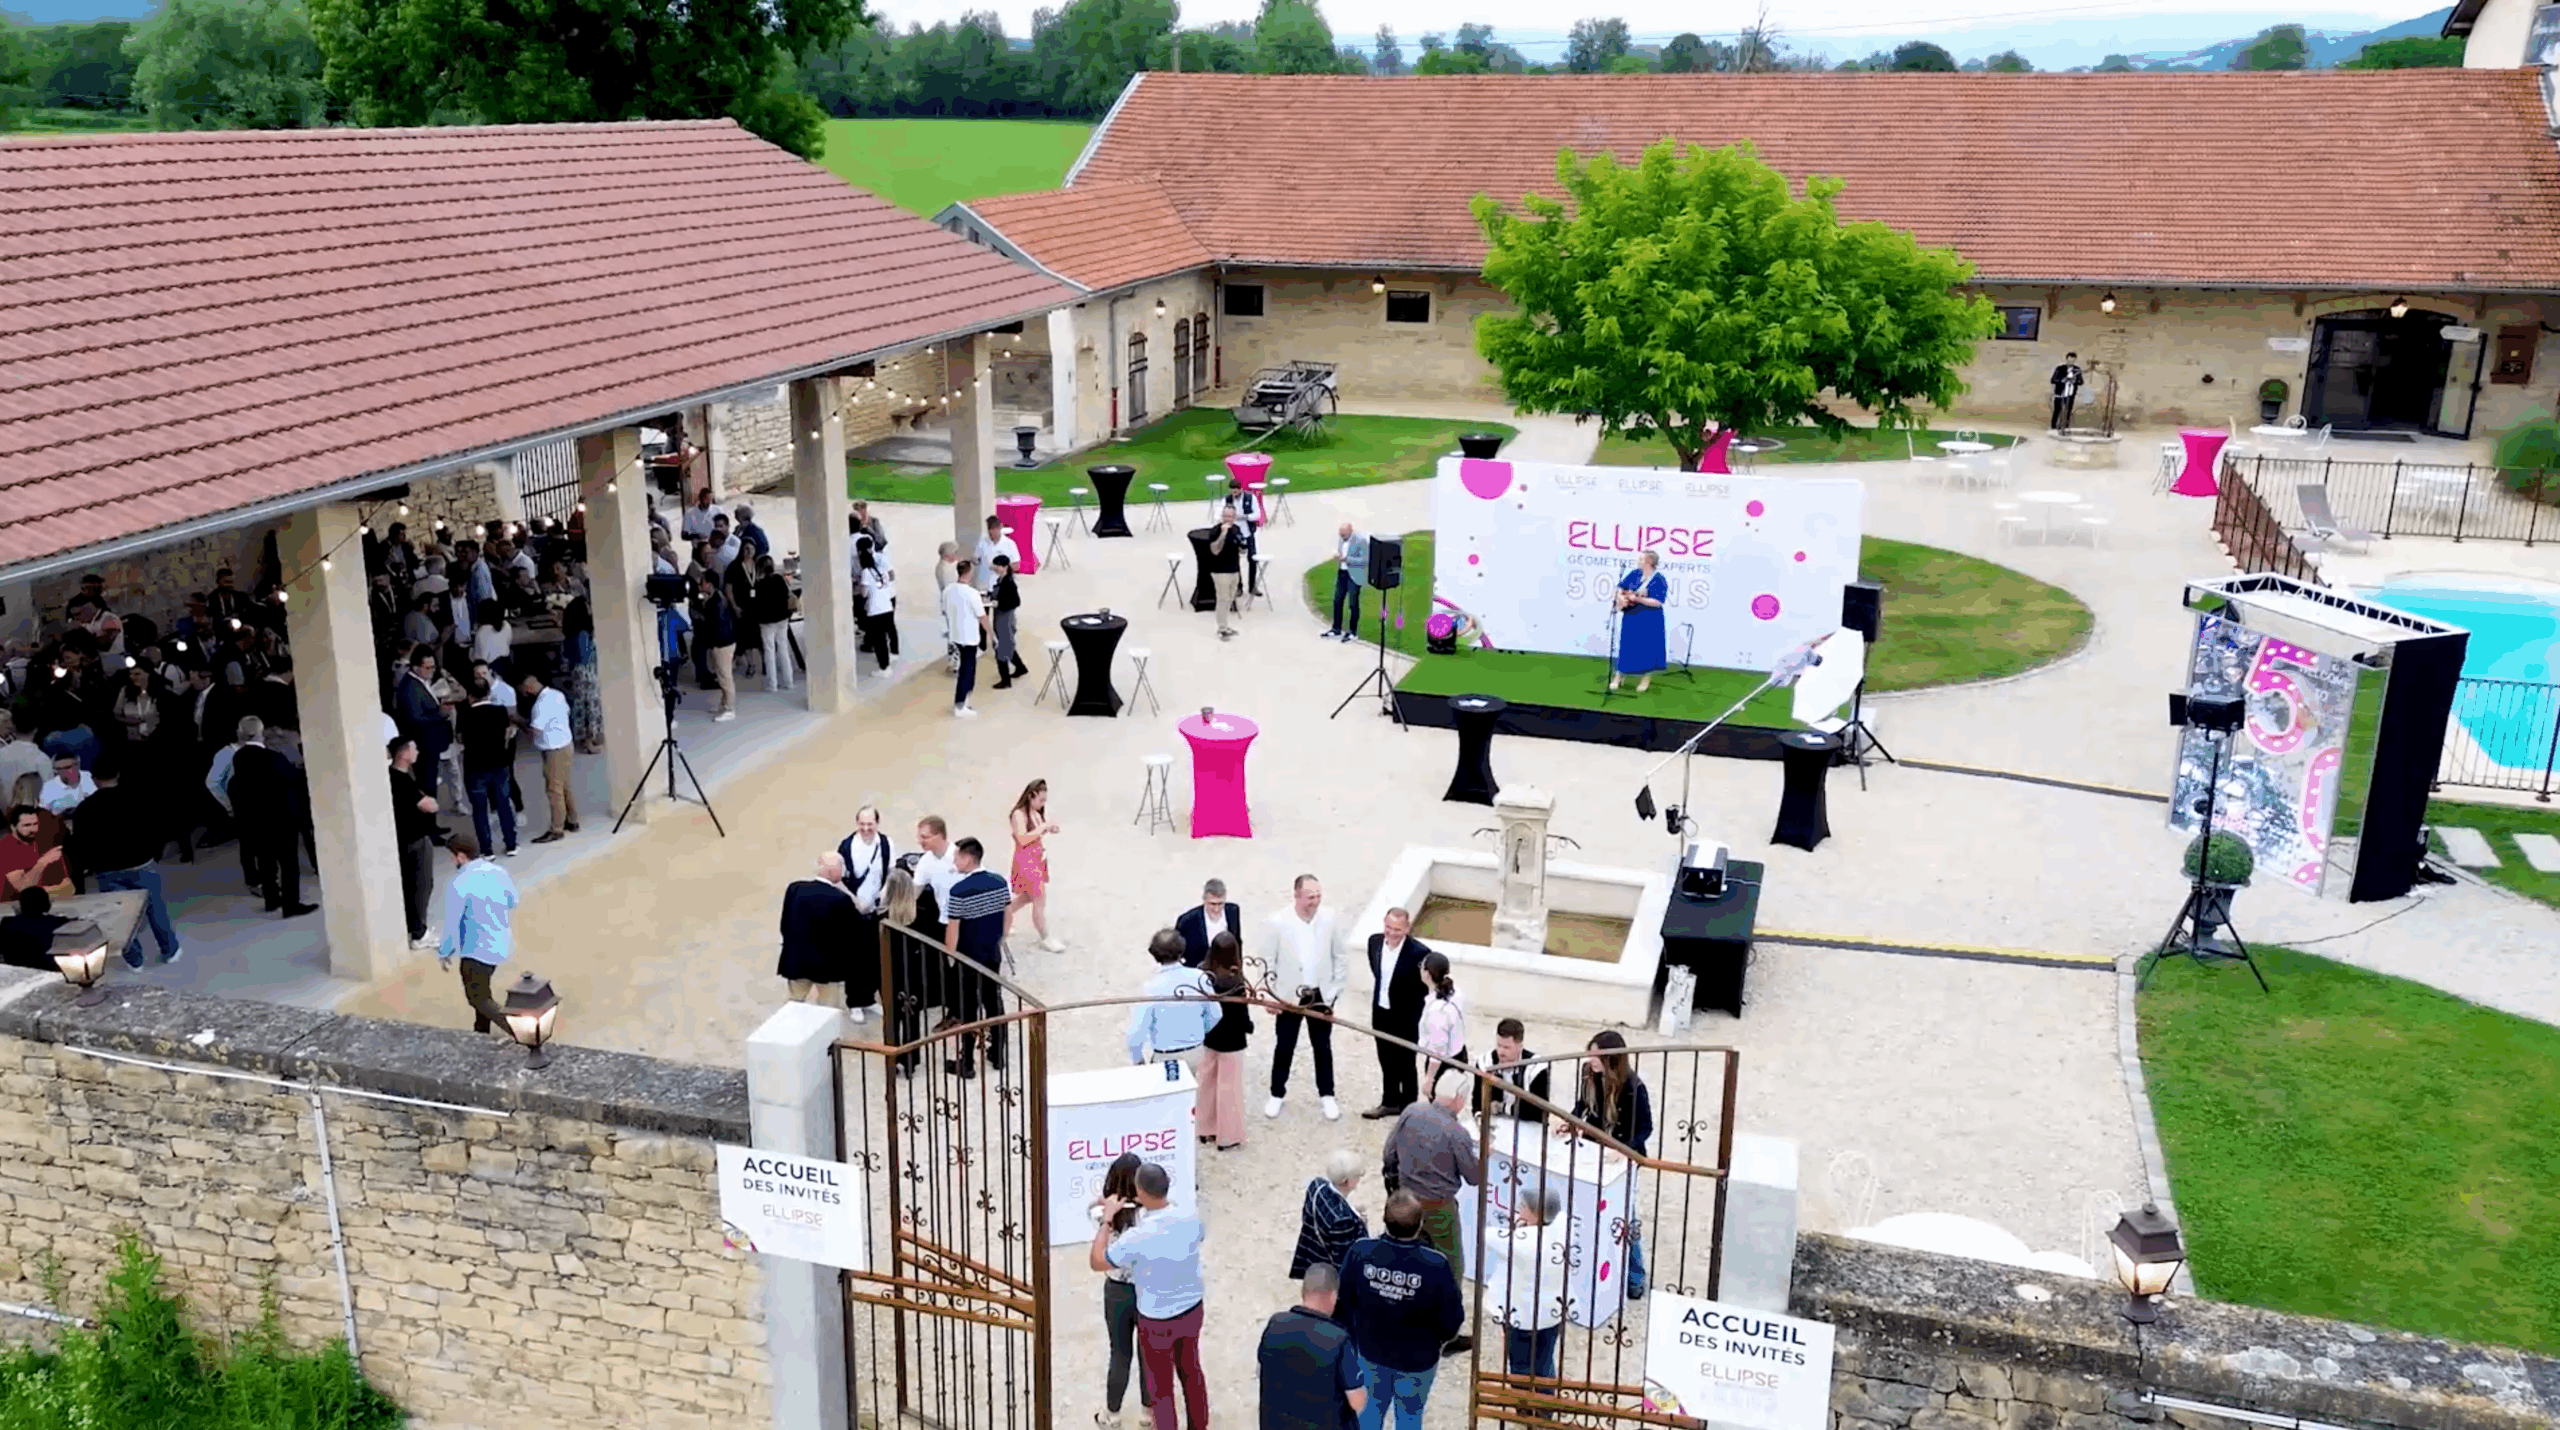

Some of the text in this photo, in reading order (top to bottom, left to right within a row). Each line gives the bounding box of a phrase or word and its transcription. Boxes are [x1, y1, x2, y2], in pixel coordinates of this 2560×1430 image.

[1568, 521, 1714, 557] ELLIPSE
[1566, 569, 1711, 610] 50 NS
[1068, 1128, 1177, 1161] ELLIPSE
[743, 1157, 839, 1187] ACCUEIL
[743, 1178, 841, 1205] DES INVITÉS
[762, 1204, 823, 1227] ELLIPSE
[1682, 1307, 1806, 1346] ACCUEIL
[1679, 1332, 1806, 1366] DES INVITÉS
[1700, 1362, 1779, 1390] ELLIPSE
